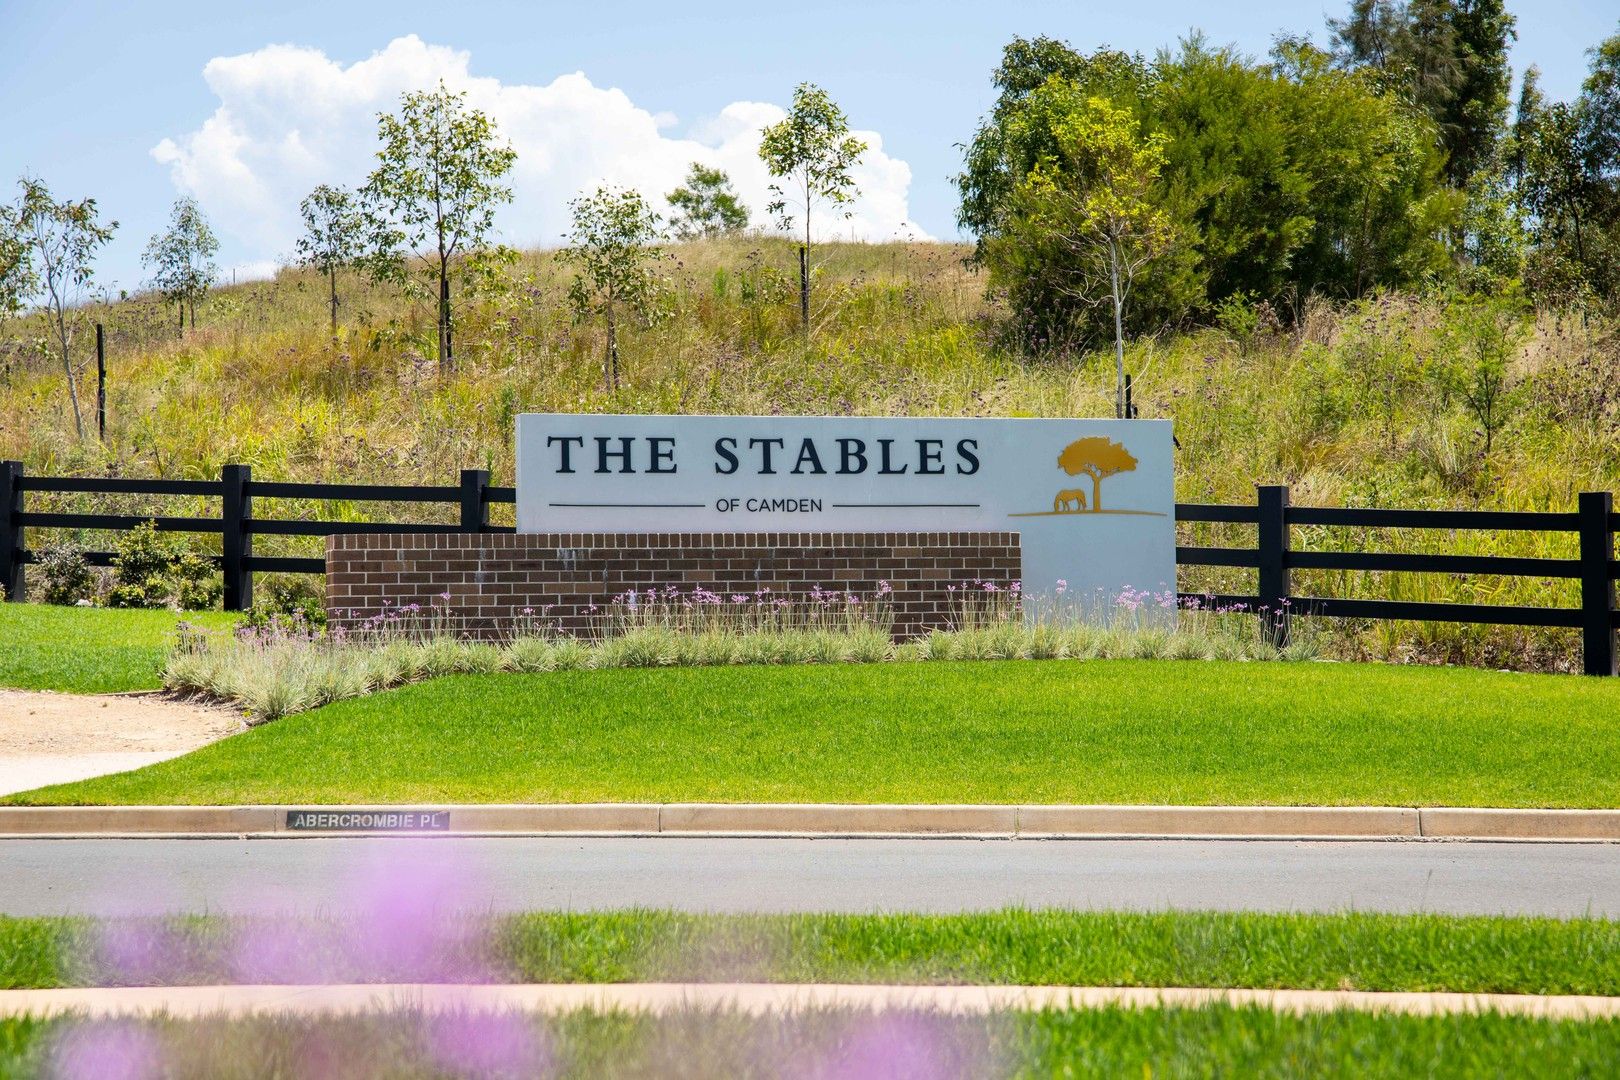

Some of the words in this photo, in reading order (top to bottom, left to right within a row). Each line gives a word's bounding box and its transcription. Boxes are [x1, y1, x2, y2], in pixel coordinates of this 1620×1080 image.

[547, 435, 678, 474] THE
[714, 437, 981, 476] STABLES
[716, 498, 742, 512] OF
[746, 498, 823, 513] CAMDEN
[295, 813, 413, 828] ABERCROMBIE
[420, 814, 440, 828] PL
